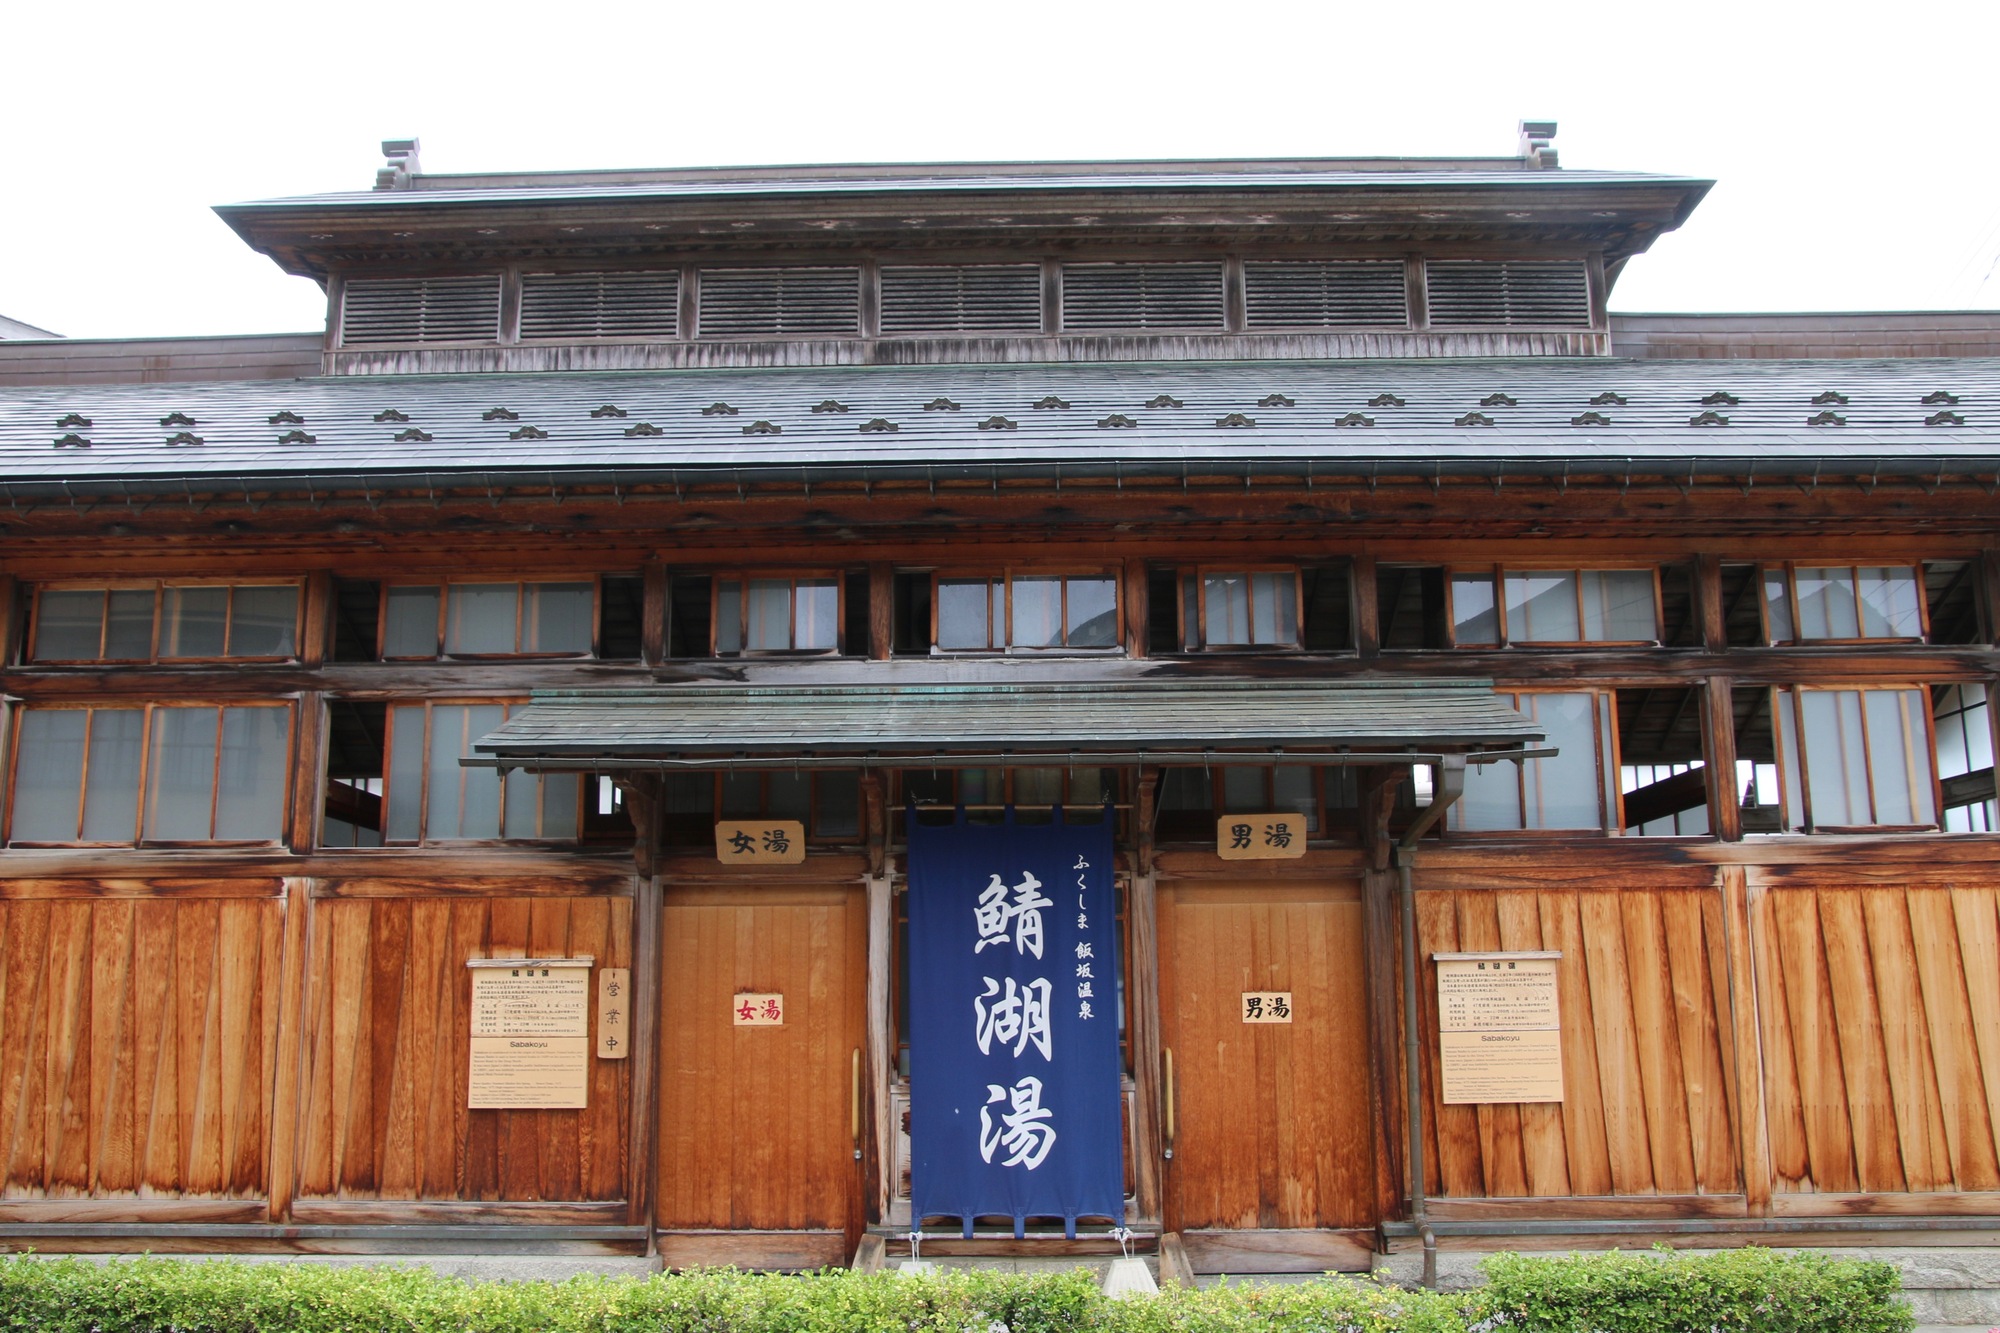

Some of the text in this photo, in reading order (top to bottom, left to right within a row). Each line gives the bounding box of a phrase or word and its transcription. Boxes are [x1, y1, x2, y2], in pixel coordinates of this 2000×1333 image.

[725, 828, 791, 855] 女湯
[1229, 822, 1293, 850] 男湯
[1073, 854, 1095, 1020] ふくしま 飯坂温泉
[606, 982, 620, 1051] 営業中
[735, 999, 783, 1021] 女湯
[973, 870, 1057, 1171] 鯖湖湯
[1246, 996, 1290, 1019] 男湯
[510, 1041, 548, 1049] Sabakoyu
[1481, 1035, 1520, 1043] Sabakoyu
